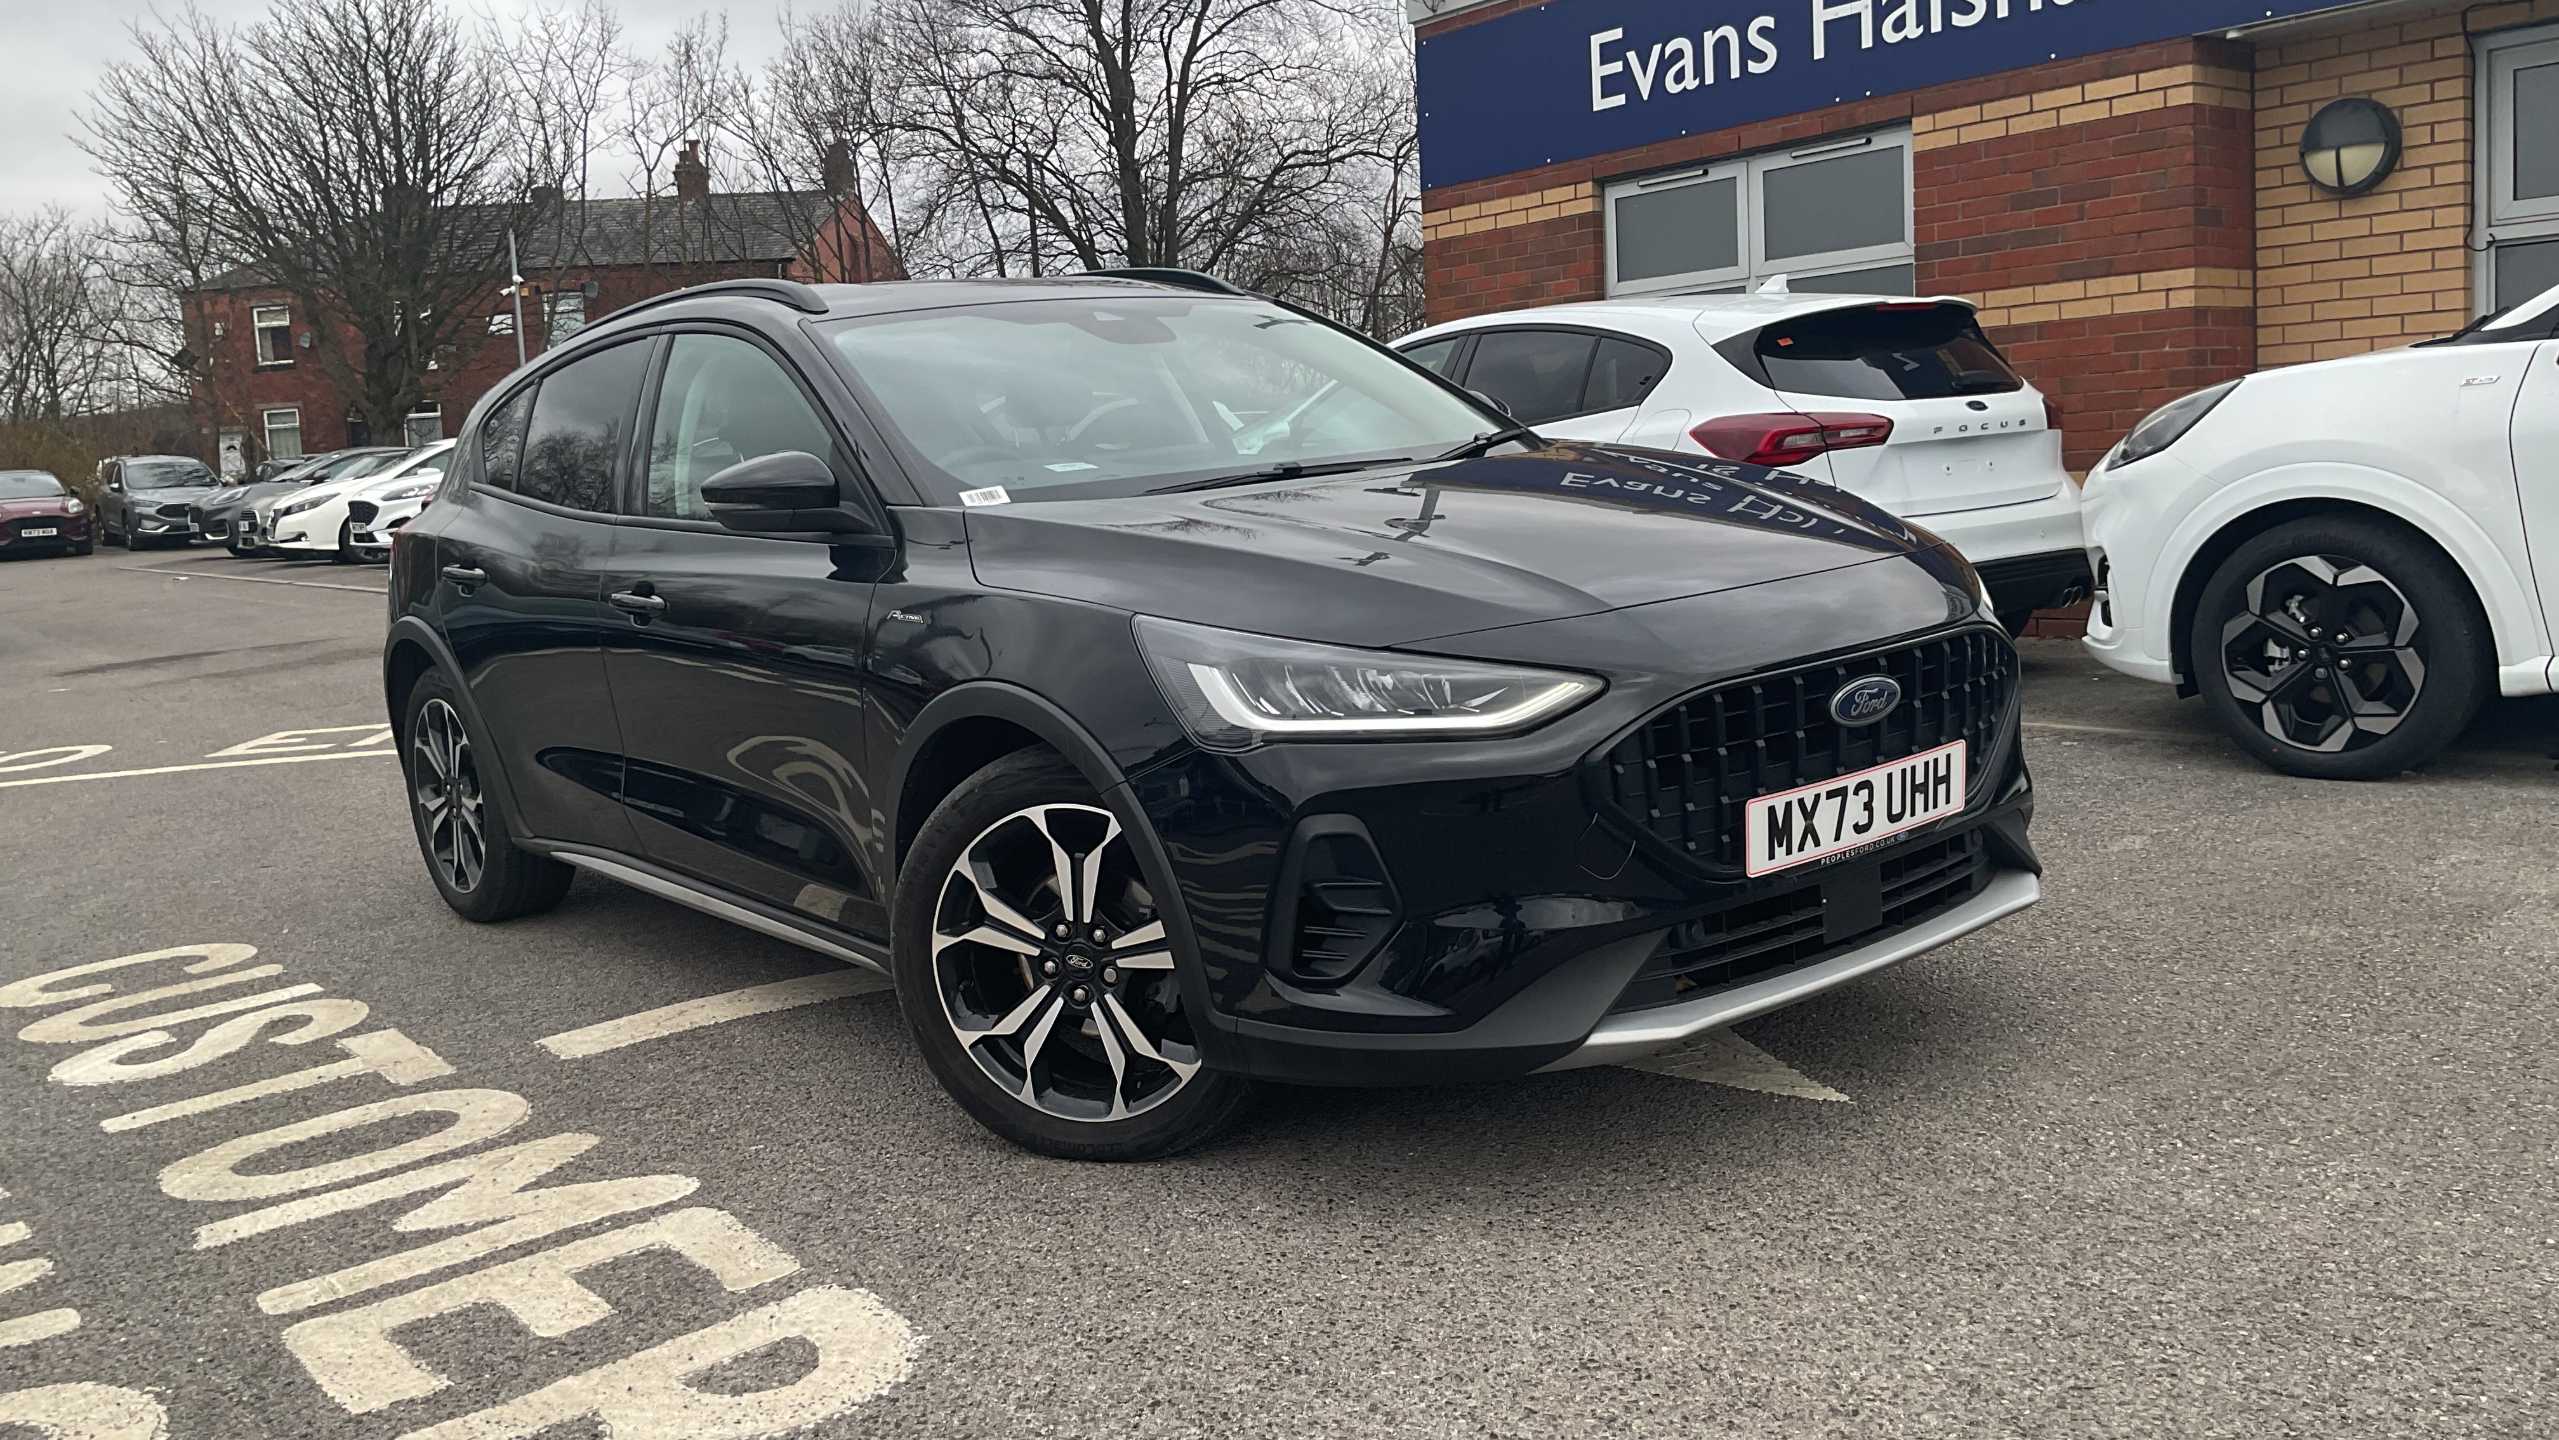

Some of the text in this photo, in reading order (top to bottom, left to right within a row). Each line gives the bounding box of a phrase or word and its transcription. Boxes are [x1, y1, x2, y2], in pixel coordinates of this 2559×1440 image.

[1590, 15, 1778, 112] Evans
[1932, 418, 2027, 435] FOCUS
[1850, 687, 1889, 716] Ford
[1767, 753, 1952, 861] MX73 UHH
